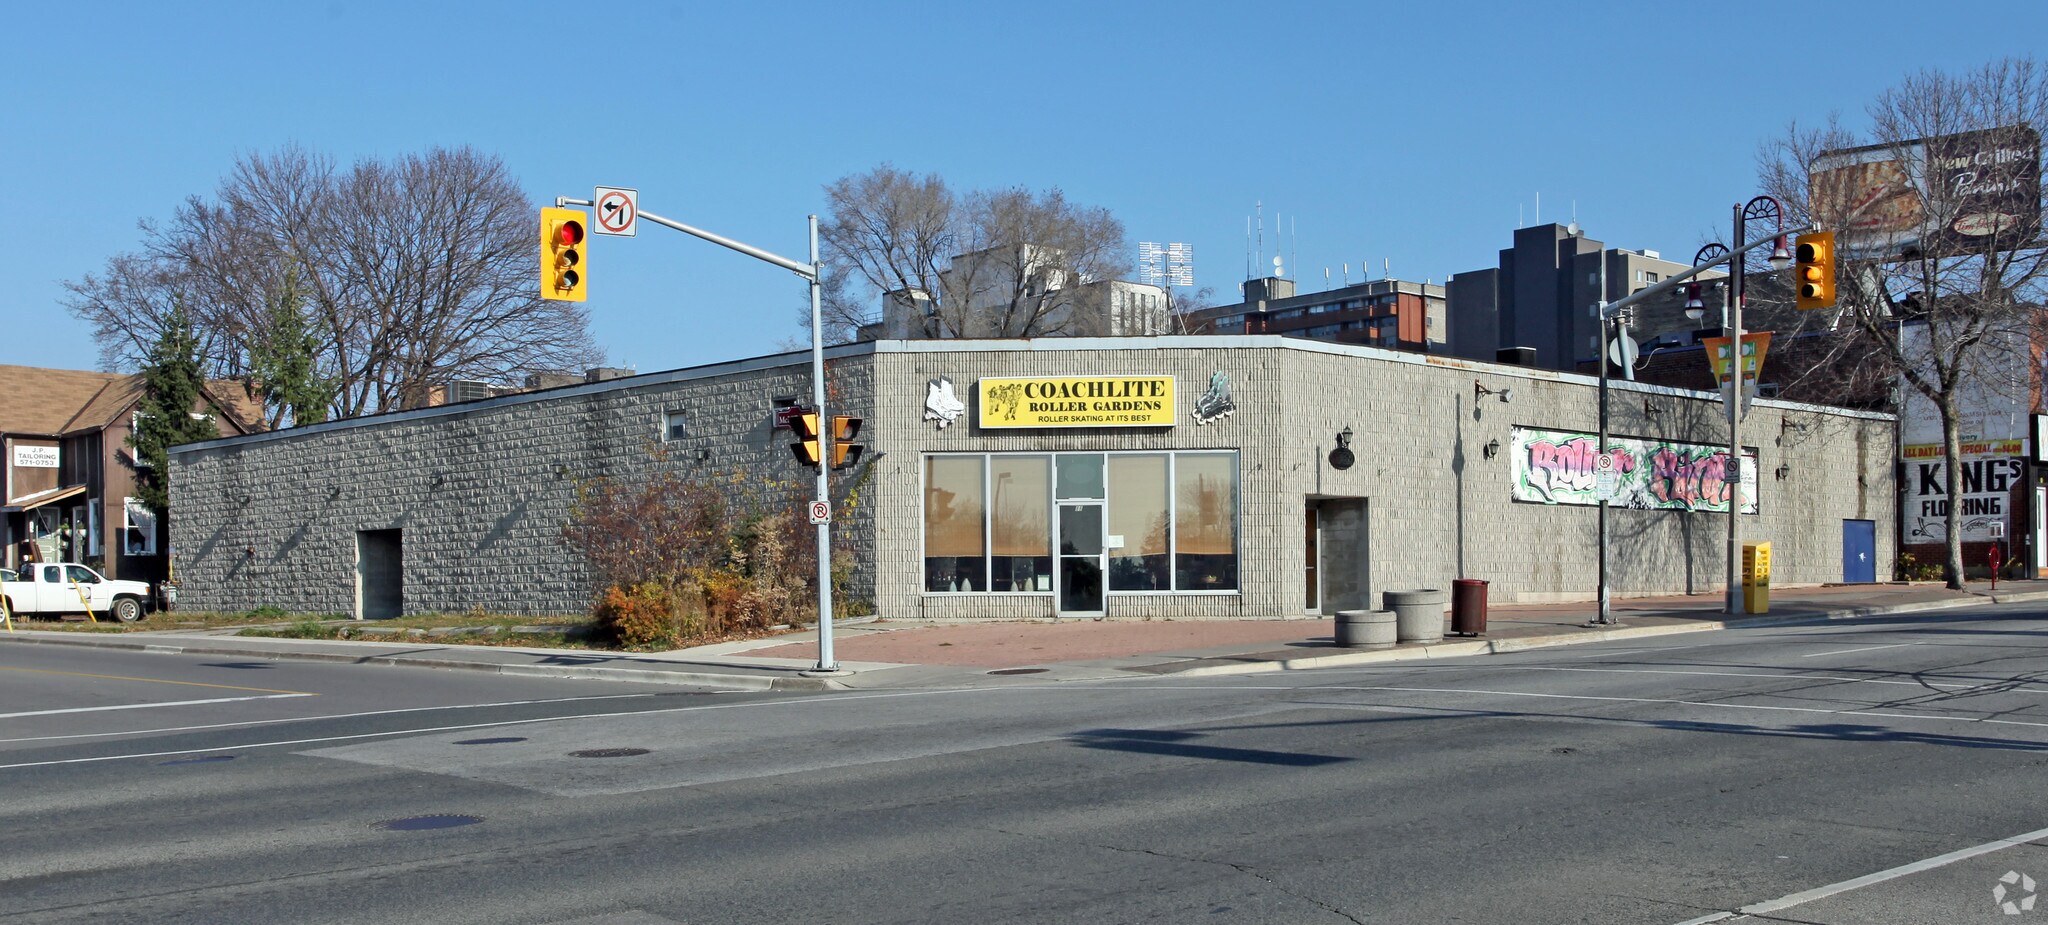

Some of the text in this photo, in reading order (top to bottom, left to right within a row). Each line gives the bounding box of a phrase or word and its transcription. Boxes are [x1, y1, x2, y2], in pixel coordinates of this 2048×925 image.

[1024, 380, 1165, 399] COACHLITE
[1029, 400, 1161, 412] ROLLER GARDENS
[1038, 415, 1069, 423] ROLLER
[1131, 414, 1152, 422] BEST
[1904, 448, 1919, 458] ALL
[1920, 446, 1936, 457] DAY
[1918, 459, 2022, 495] KNGS
[1922, 498, 2001, 517] FLORING
